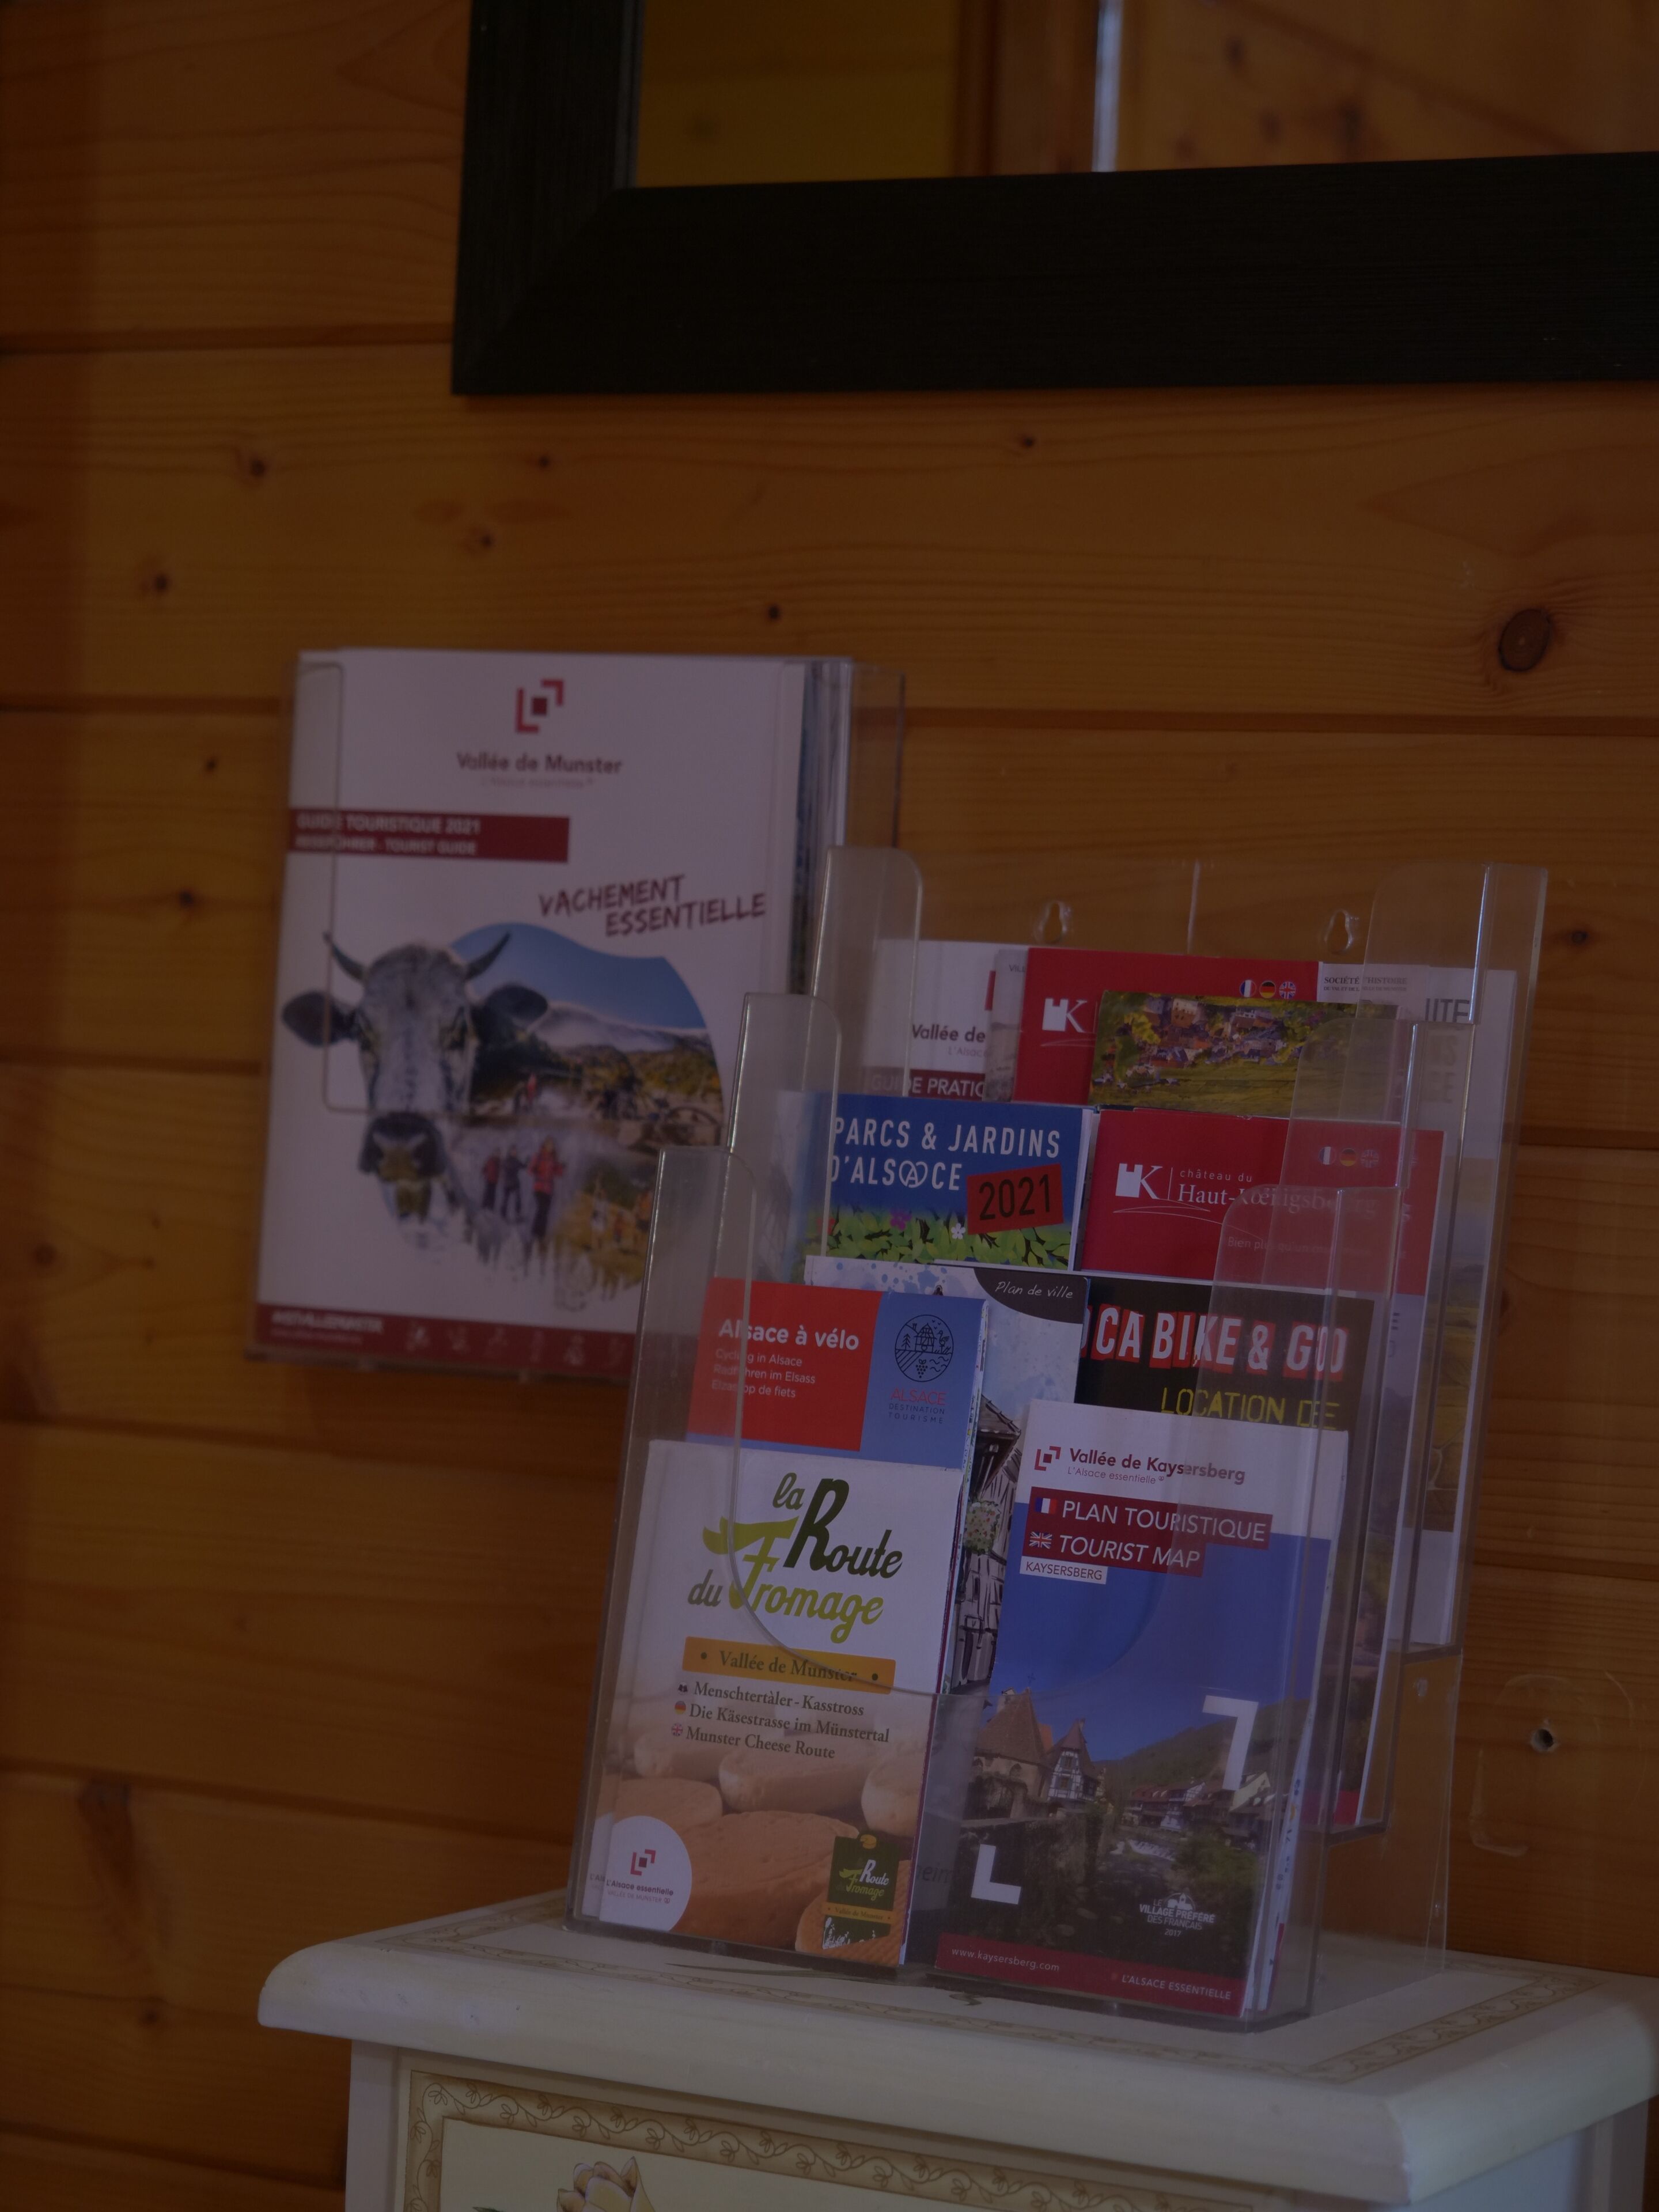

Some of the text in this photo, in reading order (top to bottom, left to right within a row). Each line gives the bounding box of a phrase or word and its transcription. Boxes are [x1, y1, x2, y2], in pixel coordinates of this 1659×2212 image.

[457, 751, 622, 774] Vallée de Munster
[539, 874, 684, 917] VACHEMENT
[605, 892, 767, 937] ESSENTIELLE
[912, 1024, 986, 1043] Vallée de
[834, 1116, 1060, 1158] PARCS & JARDINS
[1179, 1169, 1253, 1183] château du
[979, 1173, 1051, 1221] 2021
[1228, 1236, 1251, 1249] Bien
[995, 1281, 1074, 1298] Plan de ville
[718, 1318, 860, 1351] Alsace à vélo
[1152, 1312, 1242, 1368] BIKE
[1247, 1324, 1270, 1370] &
[715, 1348, 803, 1367] Cyclig in Alsace
[770, 1369, 782, 1381] im
[785, 1370, 816, 1384] Elsass
[758, 1384, 772, 1396] de
[774, 1385, 796, 1398] fiets
[889, 1387, 947, 1406] ALSACE
[888, 1402, 945, 1415] DESTINATION
[888, 1411, 944, 1425] TOURISME
[1160, 1386, 1286, 1425] LOCATION
[1067, 1466, 1157, 1484] L'Alsace essentielle
[1069, 1447, 1246, 1486] Vallée de Kaysersberg
[772, 1472, 904, 1580] la Route
[1062, 1499, 1267, 1543] PLAN TOURISTIQUE
[1059, 1534, 1201, 1569] TOURIST MAP
[687, 1516, 884, 1644] du Fromage
[1025, 1560, 1103, 1581] KAYSERSBERG
[719, 1650, 858, 1683] Vallée de Munster
[694, 1681, 793, 1707] Menschtertàler
[802, 1694, 865, 1717] Kasstross
[688, 1703, 890, 1744] Die Käsestrasse im Münstertal
[685, 1726, 836, 1760] Munster Cheese Route
[859, 1859, 889, 1886] Route
[606, 1879, 635, 1890] L'Alsace
[637, 1885, 674, 1896] essentielle
[1139, 1903, 1216, 1924] VILLAGE PRÉFÉRÉ
[1153, 1898, 1162, 1907] LE
[1147, 1915, 1203, 1930] DES FRANÇAIS
[1164, 1928, 1181, 1937] 2017
[951, 1947, 1060, 1972] www.kaysersberg.com
[1121, 1974, 1232, 2001] L'ALSACE ESSENTIELLE
